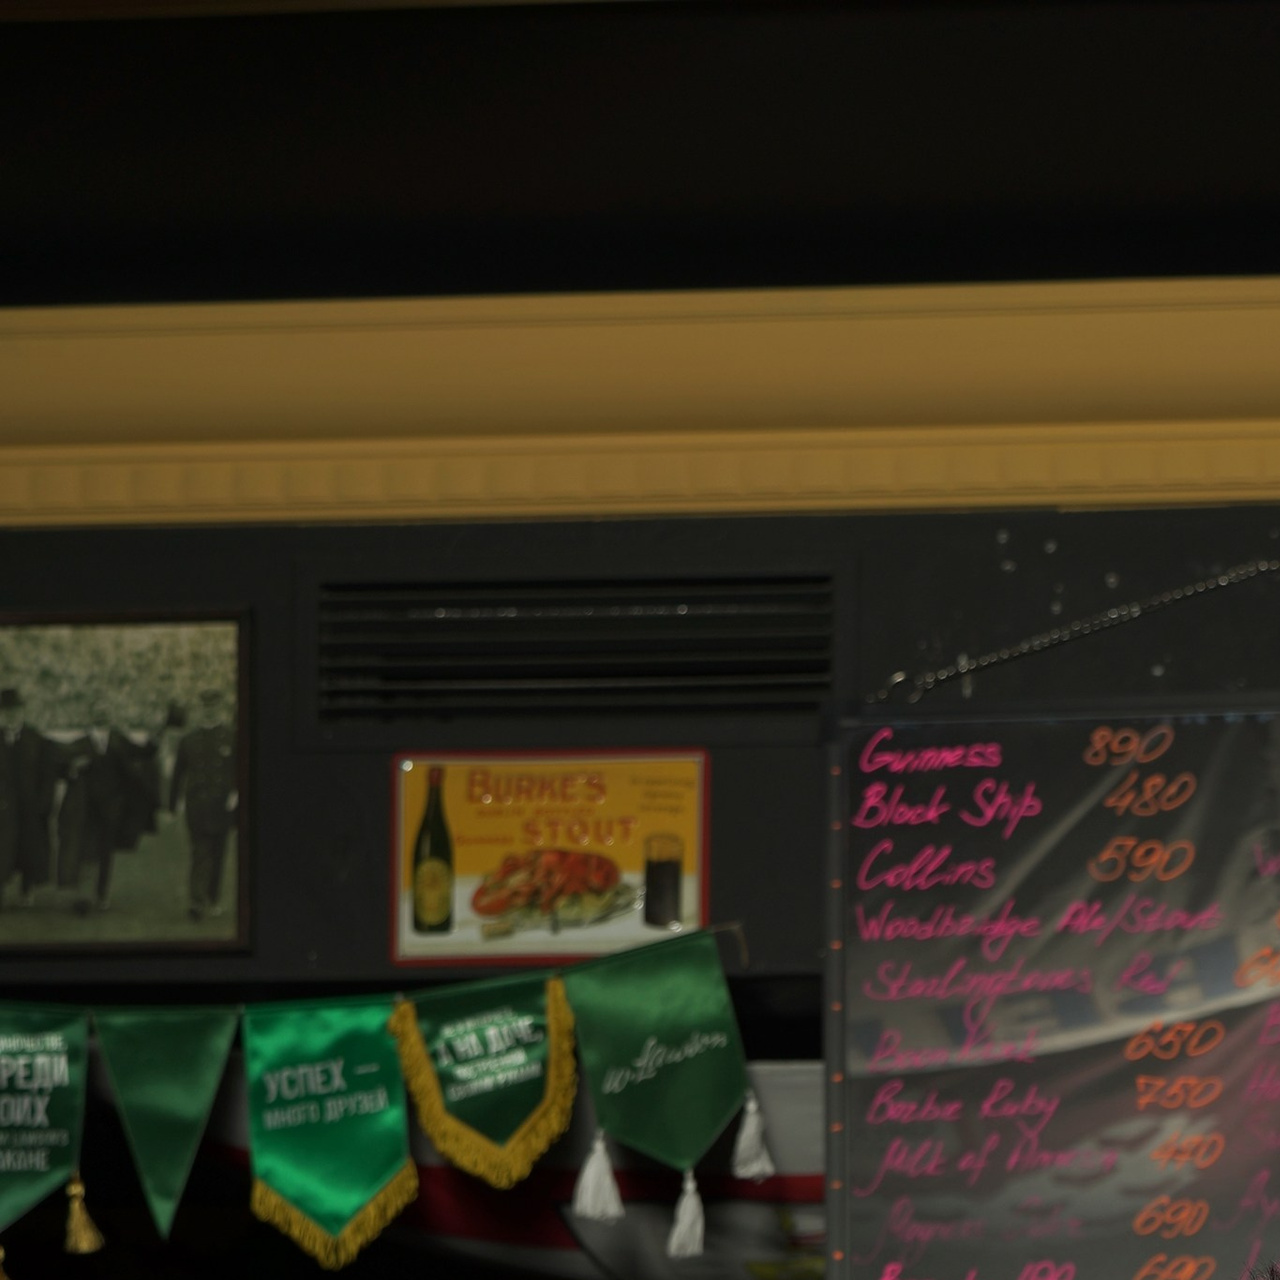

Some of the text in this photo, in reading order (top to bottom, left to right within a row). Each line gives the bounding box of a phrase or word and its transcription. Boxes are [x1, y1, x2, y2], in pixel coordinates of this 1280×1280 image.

[860, 726, 1174, 773] Guinness 890
[1103, 771, 1196, 817] 480
[523, 816, 638, 846] STOUT
[857, 839, 996, 891] Collins
[1089, 836, 1195, 883] 590
[1124, 1020, 1225, 1061] 650
[264, 1056, 347, 1104] УСПЕХ
[979, 1078, 1061, 1138] Ruby
[956, 1131, 1000, 1187] of
[1132, 1194, 1210, 1240] 690
